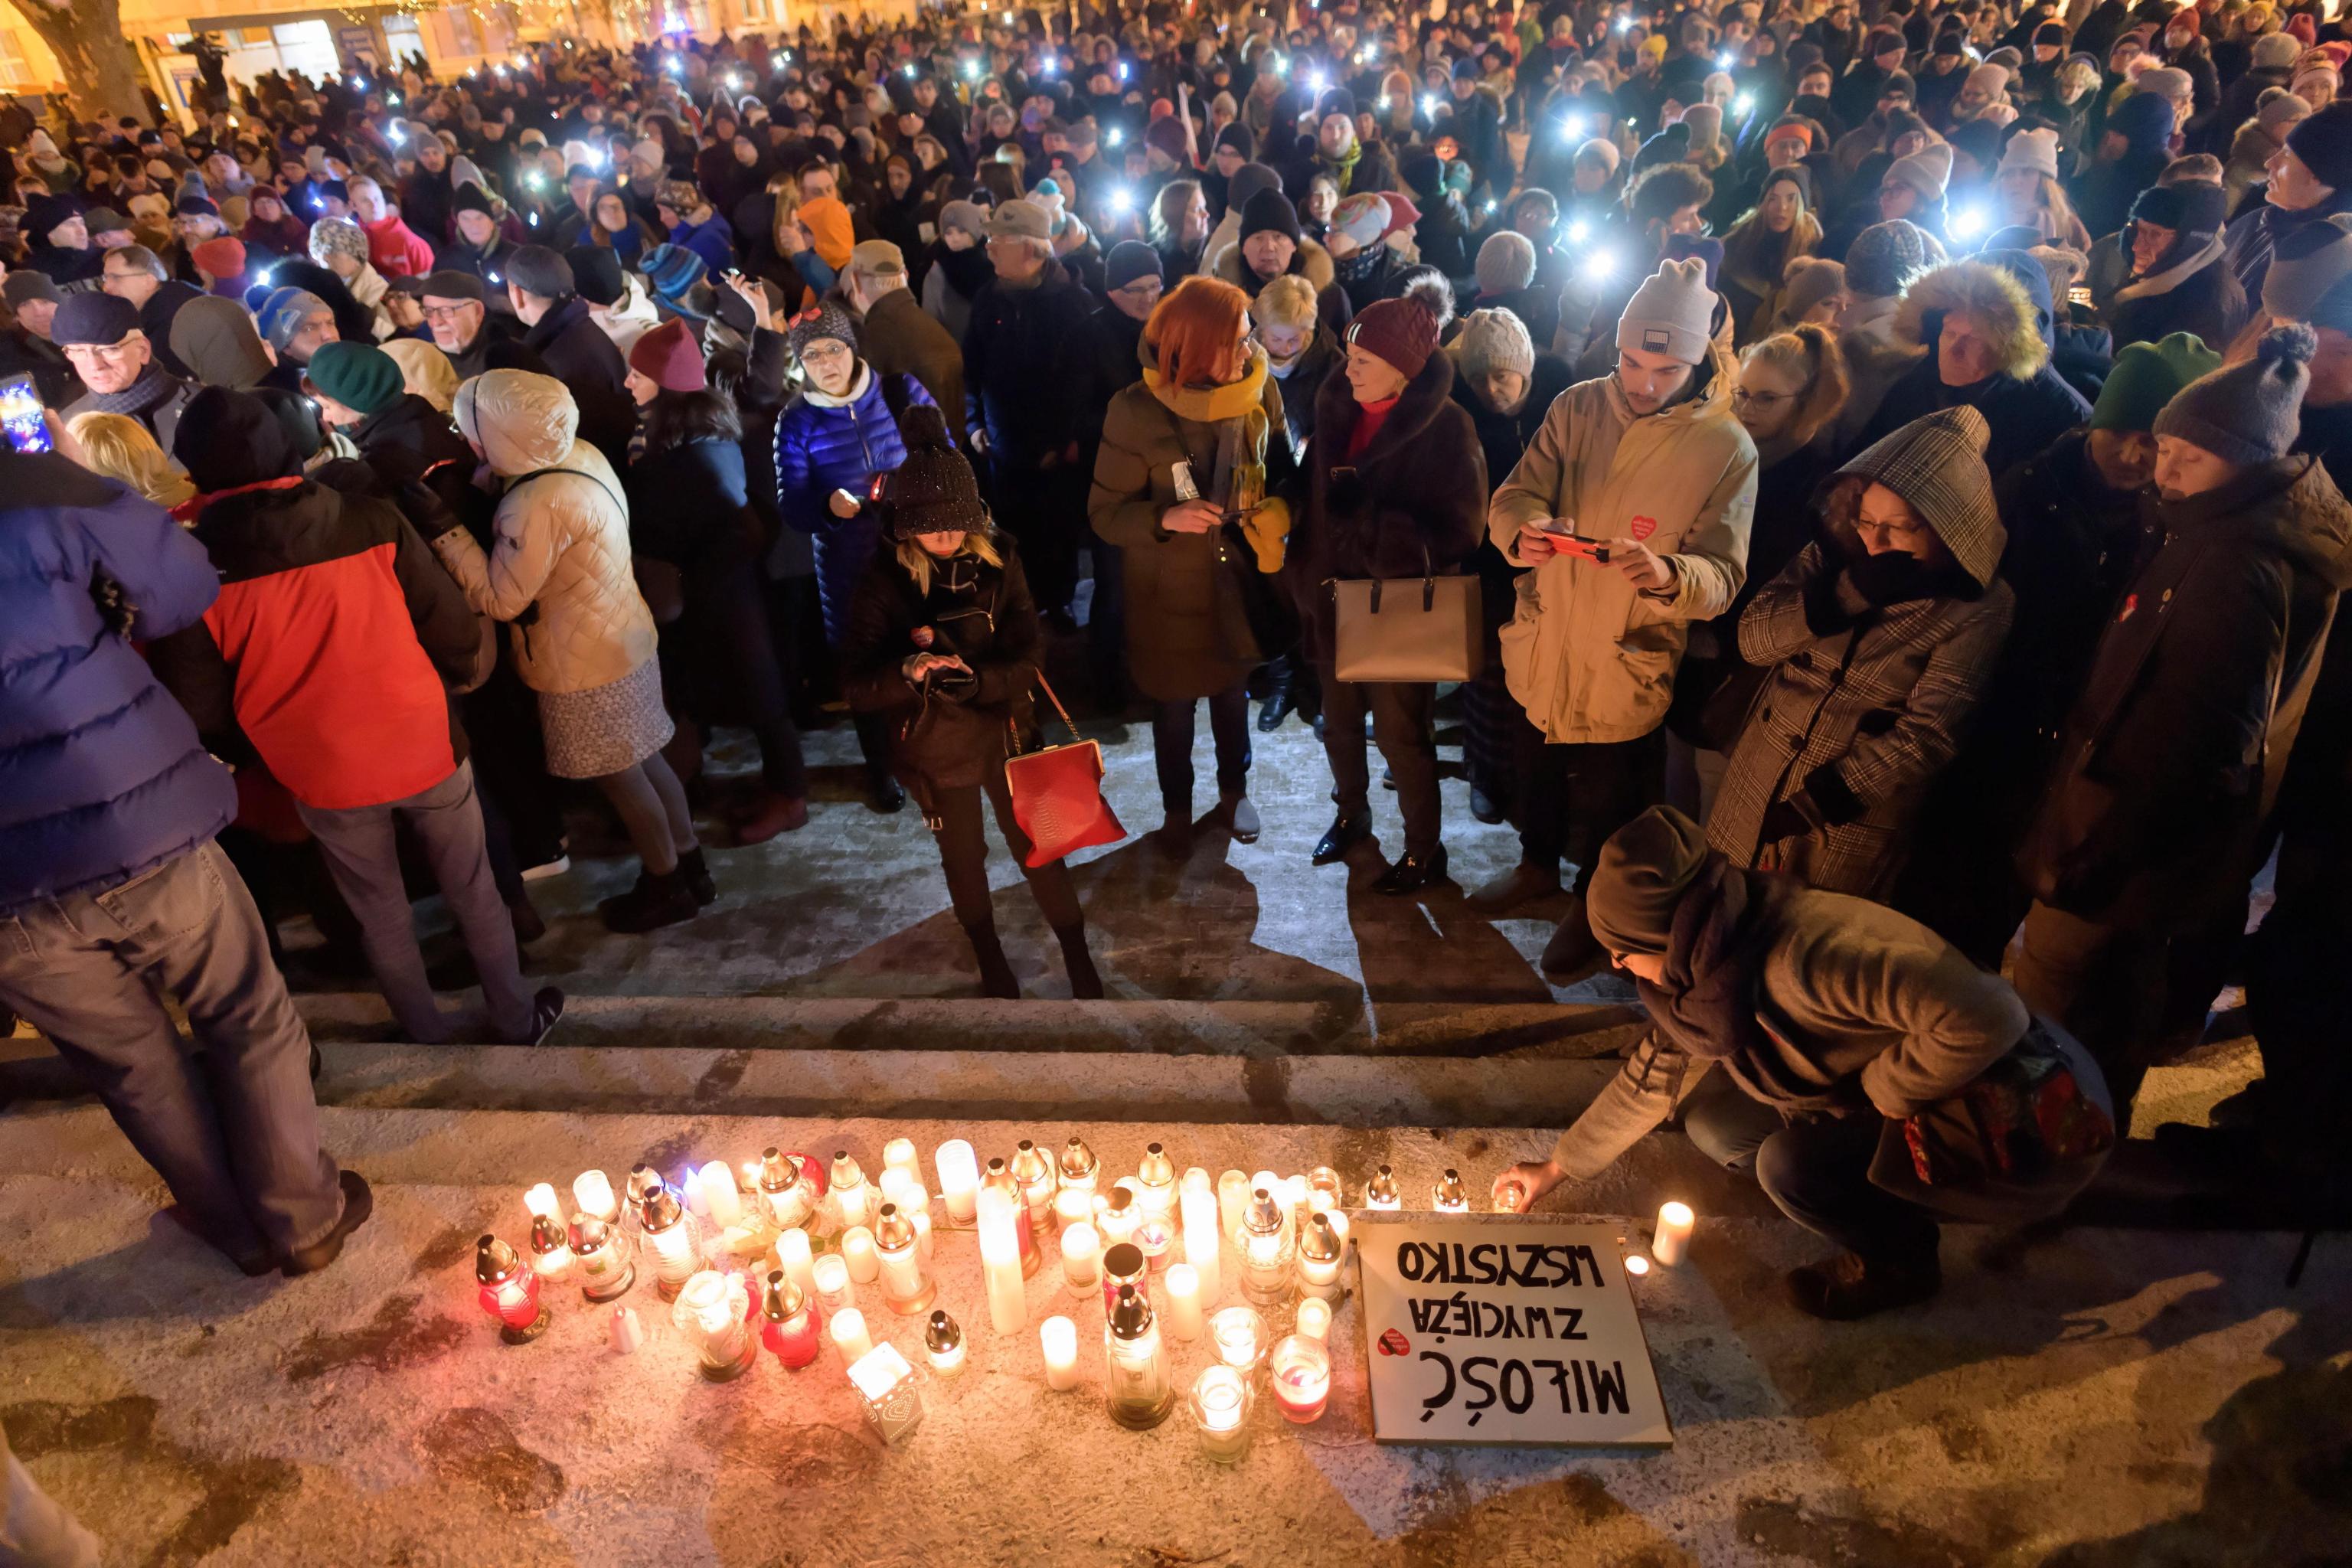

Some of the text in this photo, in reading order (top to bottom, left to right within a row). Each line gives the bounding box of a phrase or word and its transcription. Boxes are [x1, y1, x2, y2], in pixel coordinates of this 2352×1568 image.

[1397, 1242, 1605, 1289] WSZYSTKO
[1407, 1291, 1588, 1344] ZWYCIĘŻA
[1419, 1351, 1630, 1427] MIŁOŚĆ
